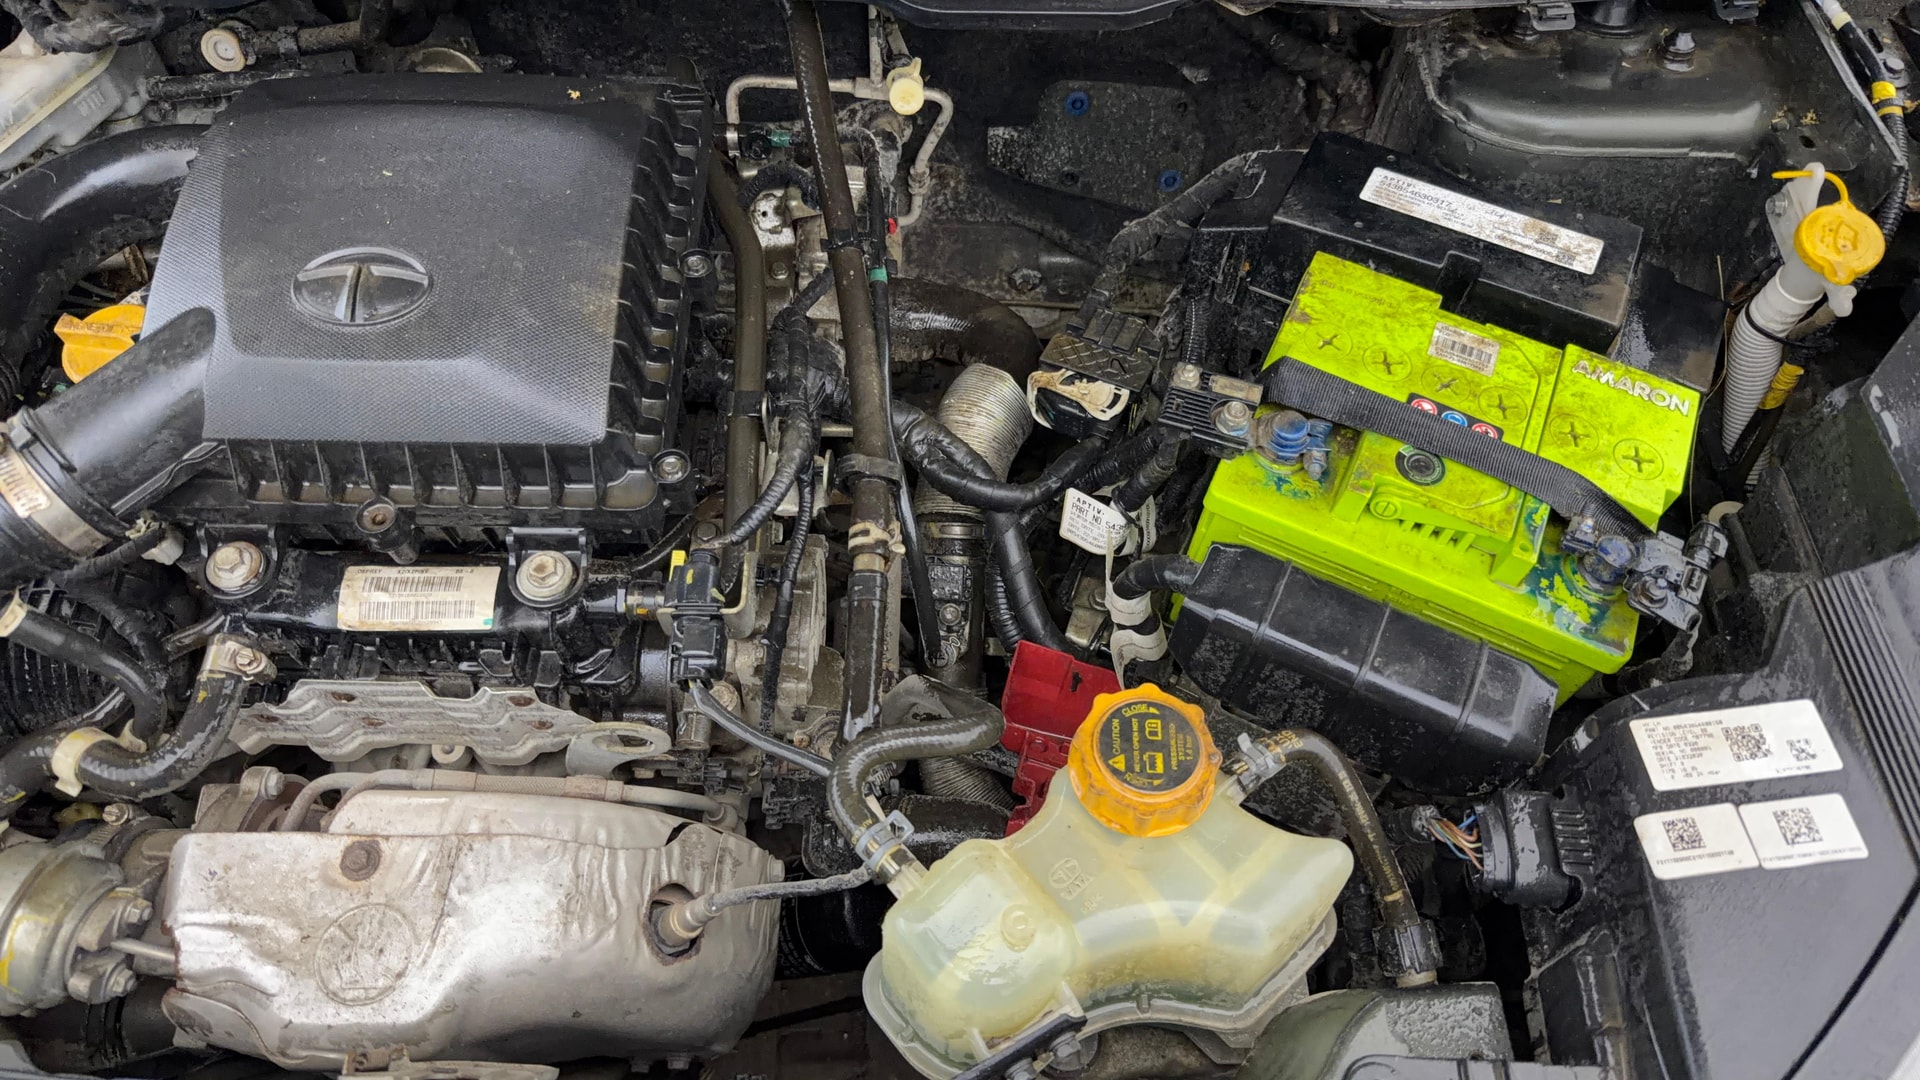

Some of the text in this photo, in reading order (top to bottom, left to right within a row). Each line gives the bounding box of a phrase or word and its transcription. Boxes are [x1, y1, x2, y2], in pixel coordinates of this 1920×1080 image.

[1572, 359, 1691, 417] AMARON
[1071, 502, 1089, 517] PART
[1076, 497, 1102, 515] APTIV
[1121, 703, 1148, 717] CLOSE
[1111, 718, 1121, 754] CAUTION
